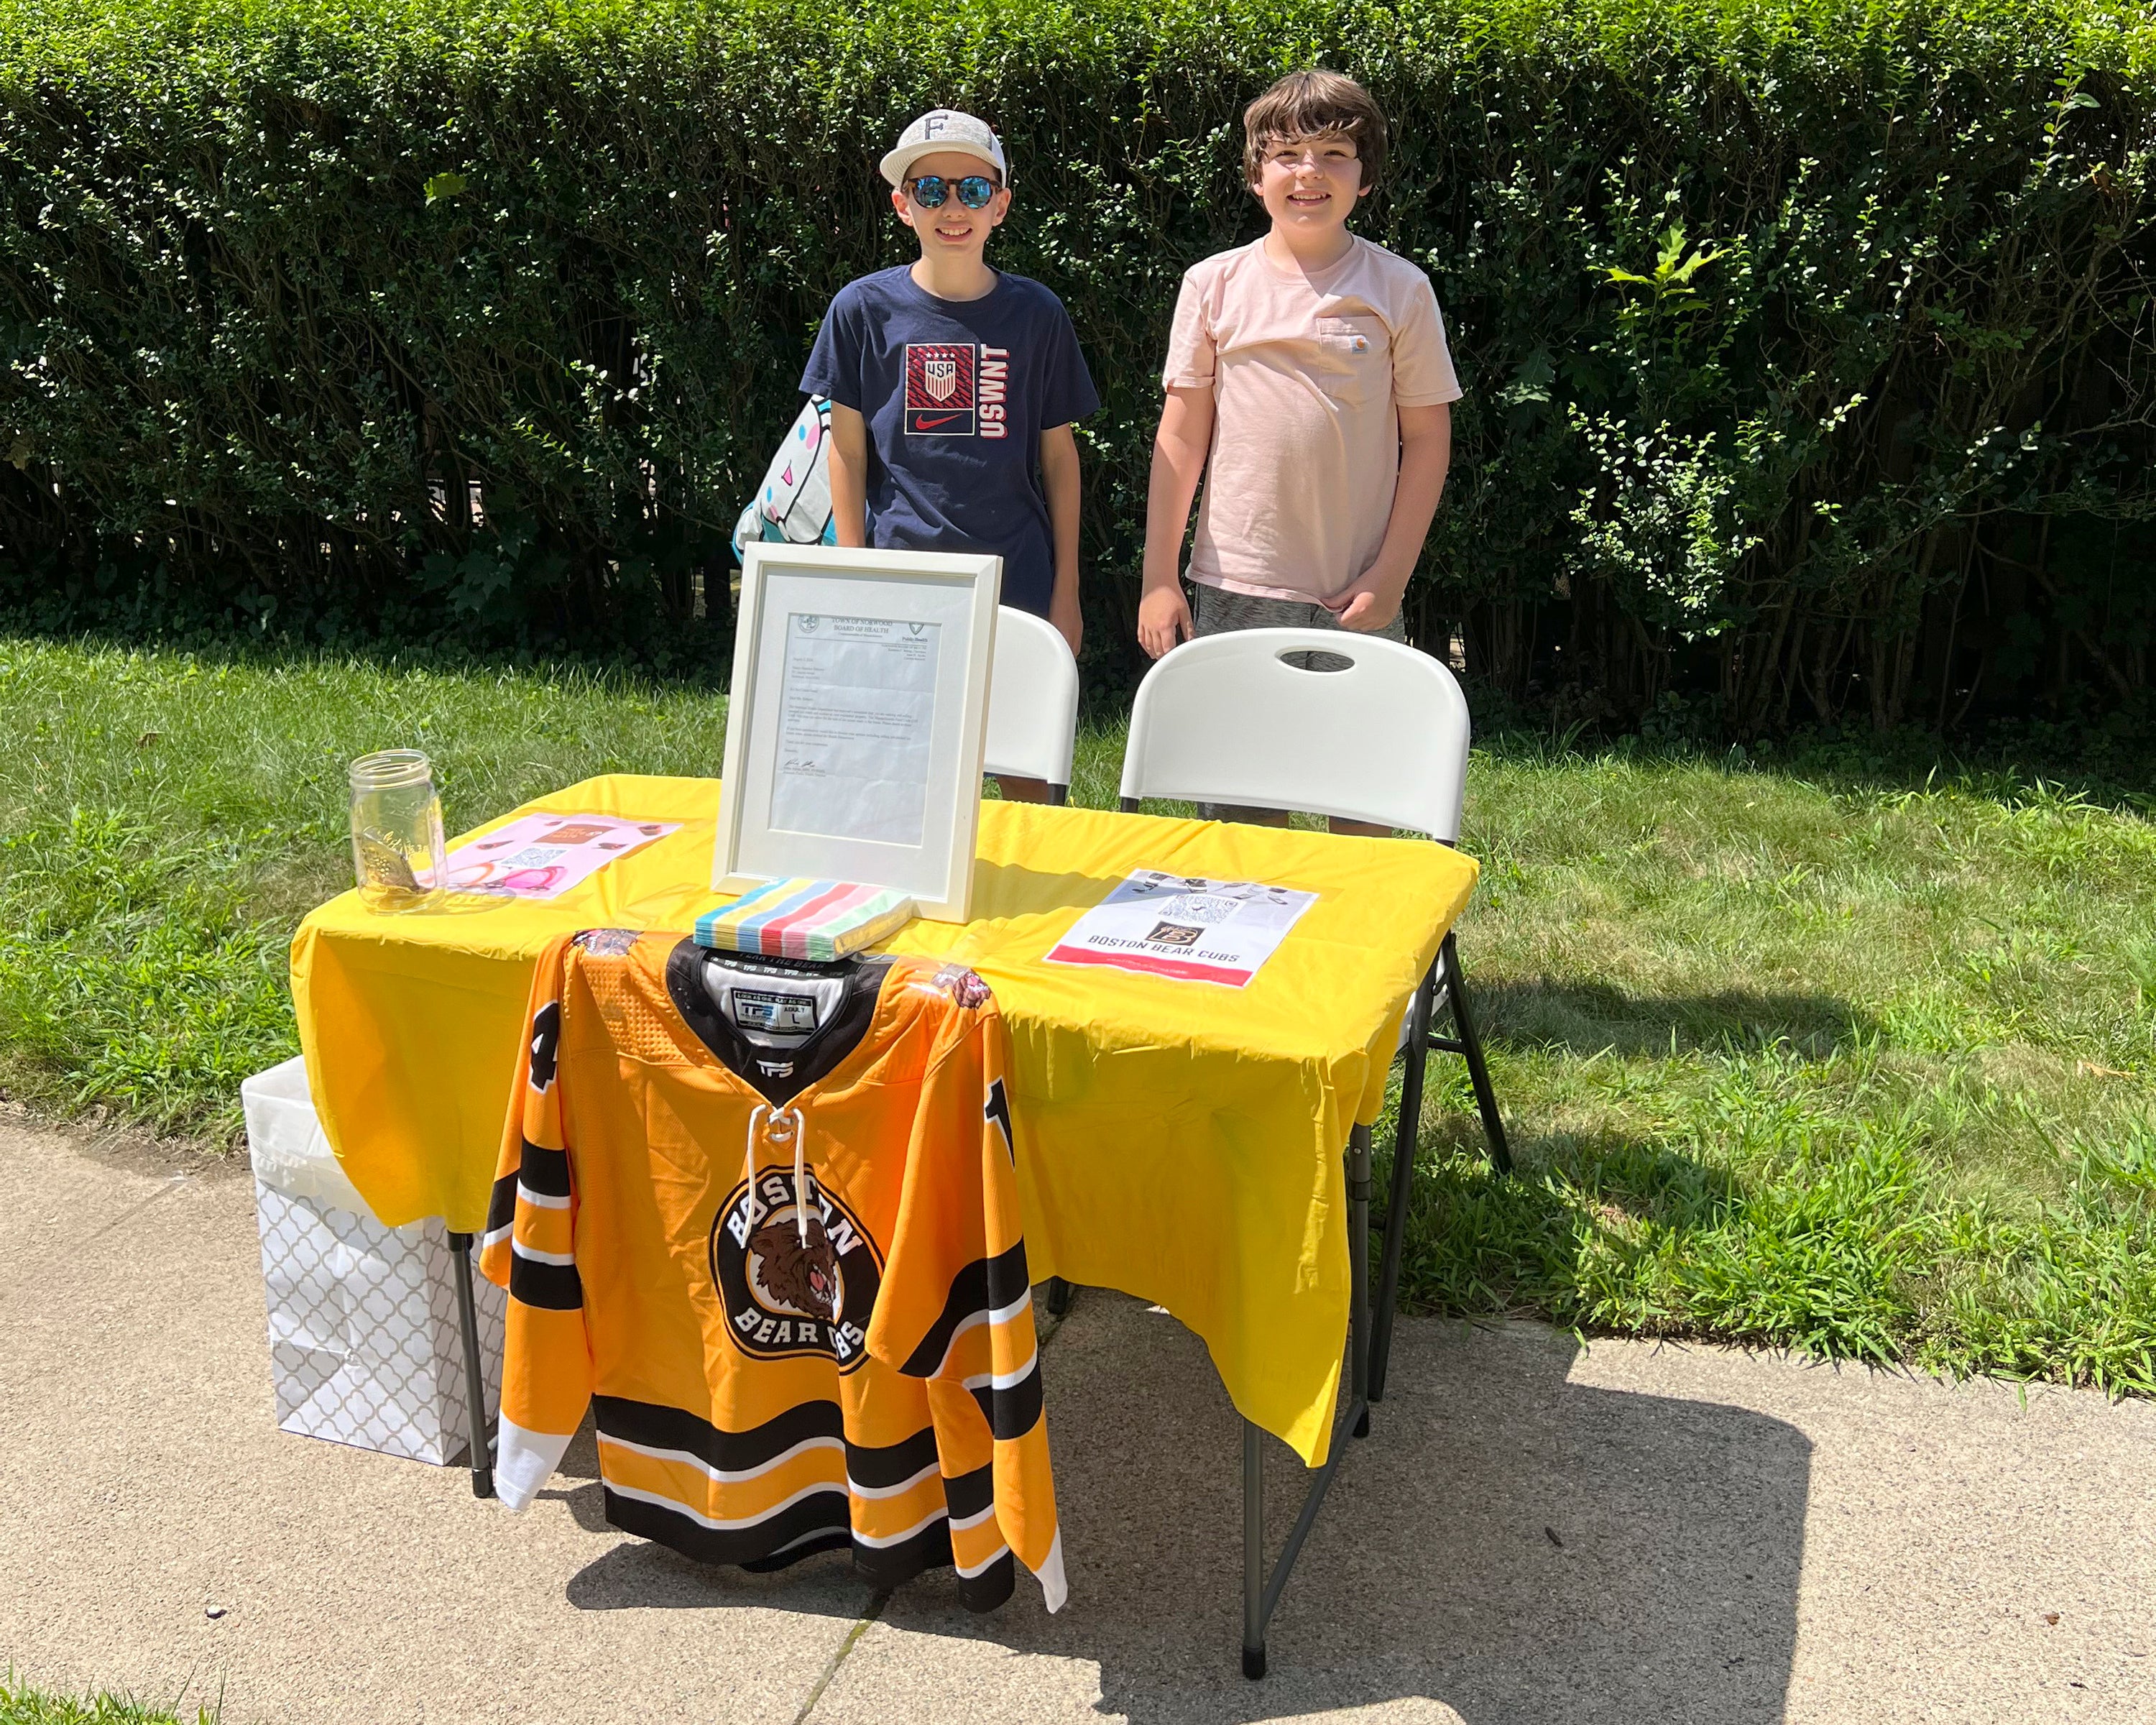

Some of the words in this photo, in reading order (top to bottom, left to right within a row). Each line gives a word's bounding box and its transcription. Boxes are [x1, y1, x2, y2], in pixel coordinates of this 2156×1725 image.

[924, 114, 949, 140] F
[927, 363, 954, 378] USA
[979, 344, 1010, 439] USWNT
[1087, 935, 1148, 949] BOSTON
[1151, 944, 1194, 956] BEAR
[1197, 949, 1240, 962] CUBS
[741, 1002, 774, 1016] TPS
[791, 1013, 801, 1024] L
[756, 1059, 794, 1079] TPS
[734, 1306, 819, 1343] BEAR
